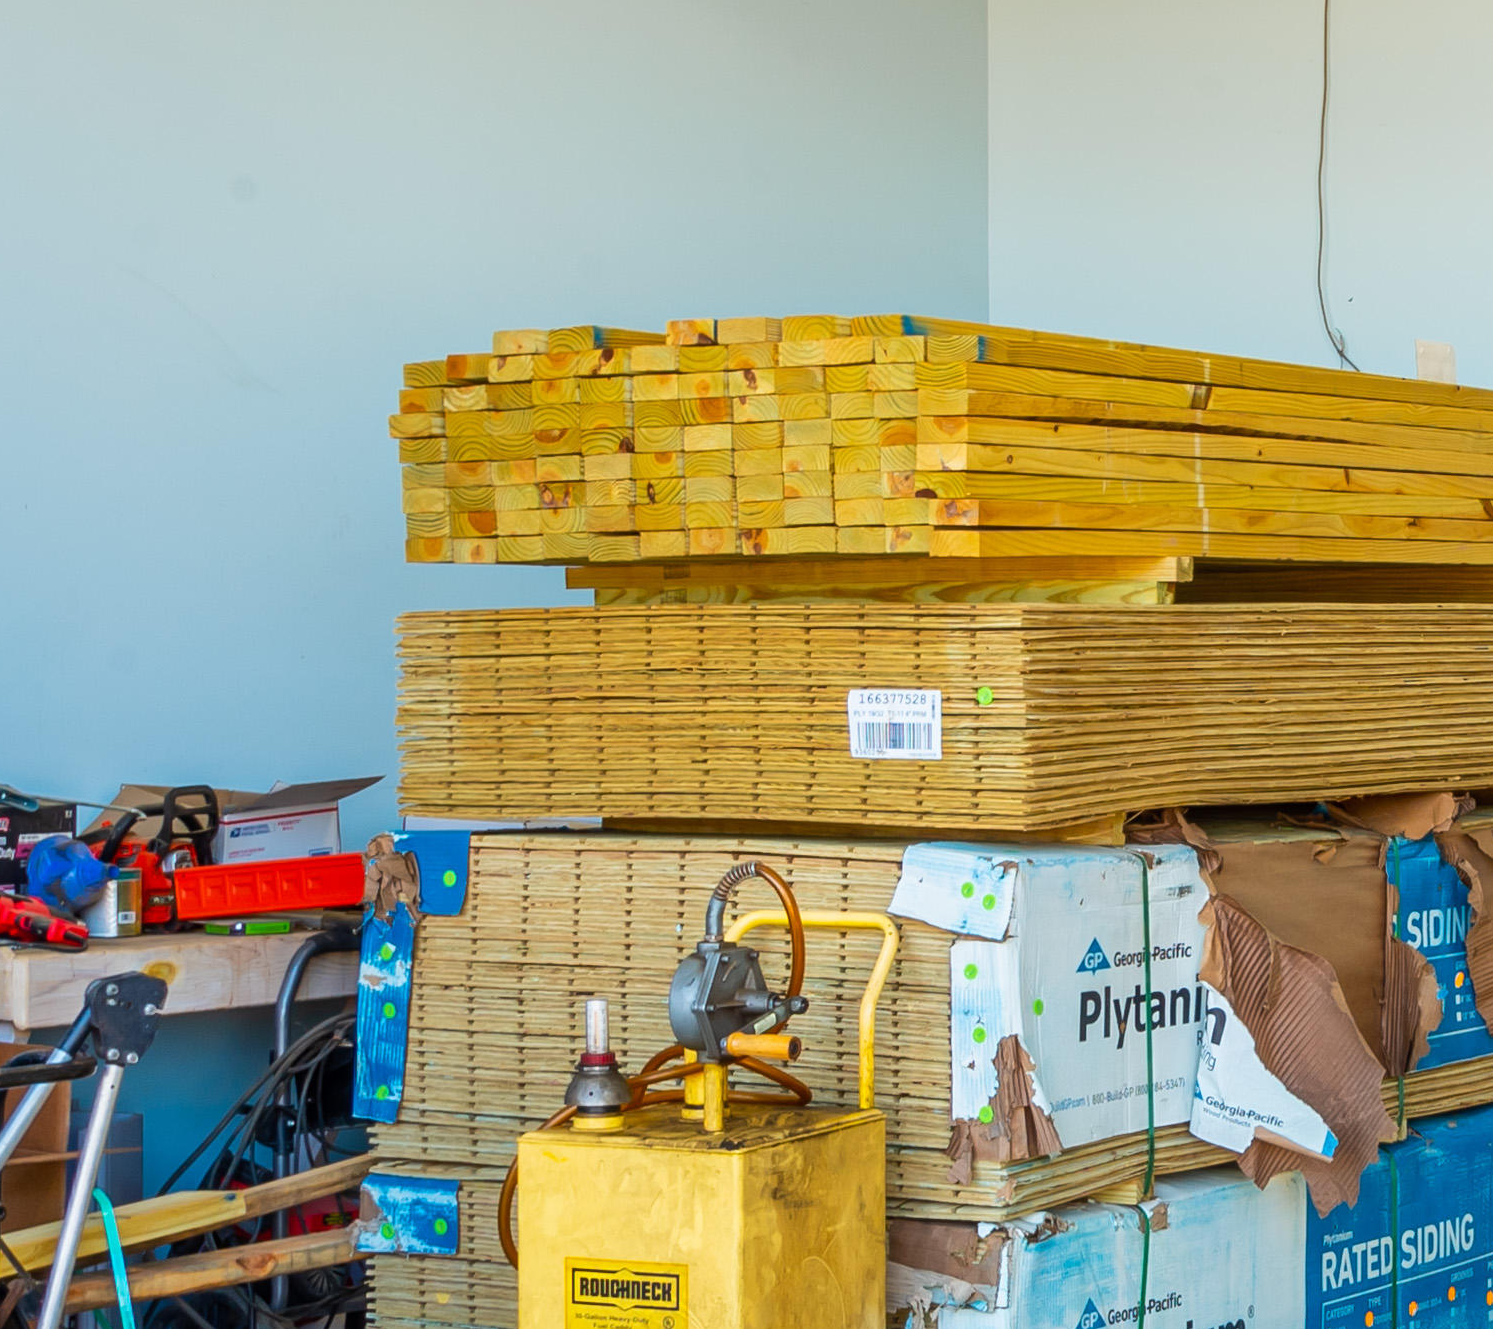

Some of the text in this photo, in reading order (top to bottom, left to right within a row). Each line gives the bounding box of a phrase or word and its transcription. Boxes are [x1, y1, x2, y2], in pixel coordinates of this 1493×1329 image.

[859, 693, 926, 704] 166377528
[1407, 906, 1470, 949] SIDIN
[1084, 943, 1192, 969] GP Georgi-Pacific
[1079, 974, 1204, 1050] Plytani
[1205, 1095, 1285, 1128] Georgia-Pacific
[1323, 1230, 1354, 1248] Plytanium
[1322, 1213, 1475, 1292] RATED SIDING
[579, 1277, 672, 1302] ROUGHNECK
[1368, 1296, 1382, 1307] TYPE
[1081, 1312, 1098, 1328] GP
[1326, 1305, 1355, 1321] CATEGORY
